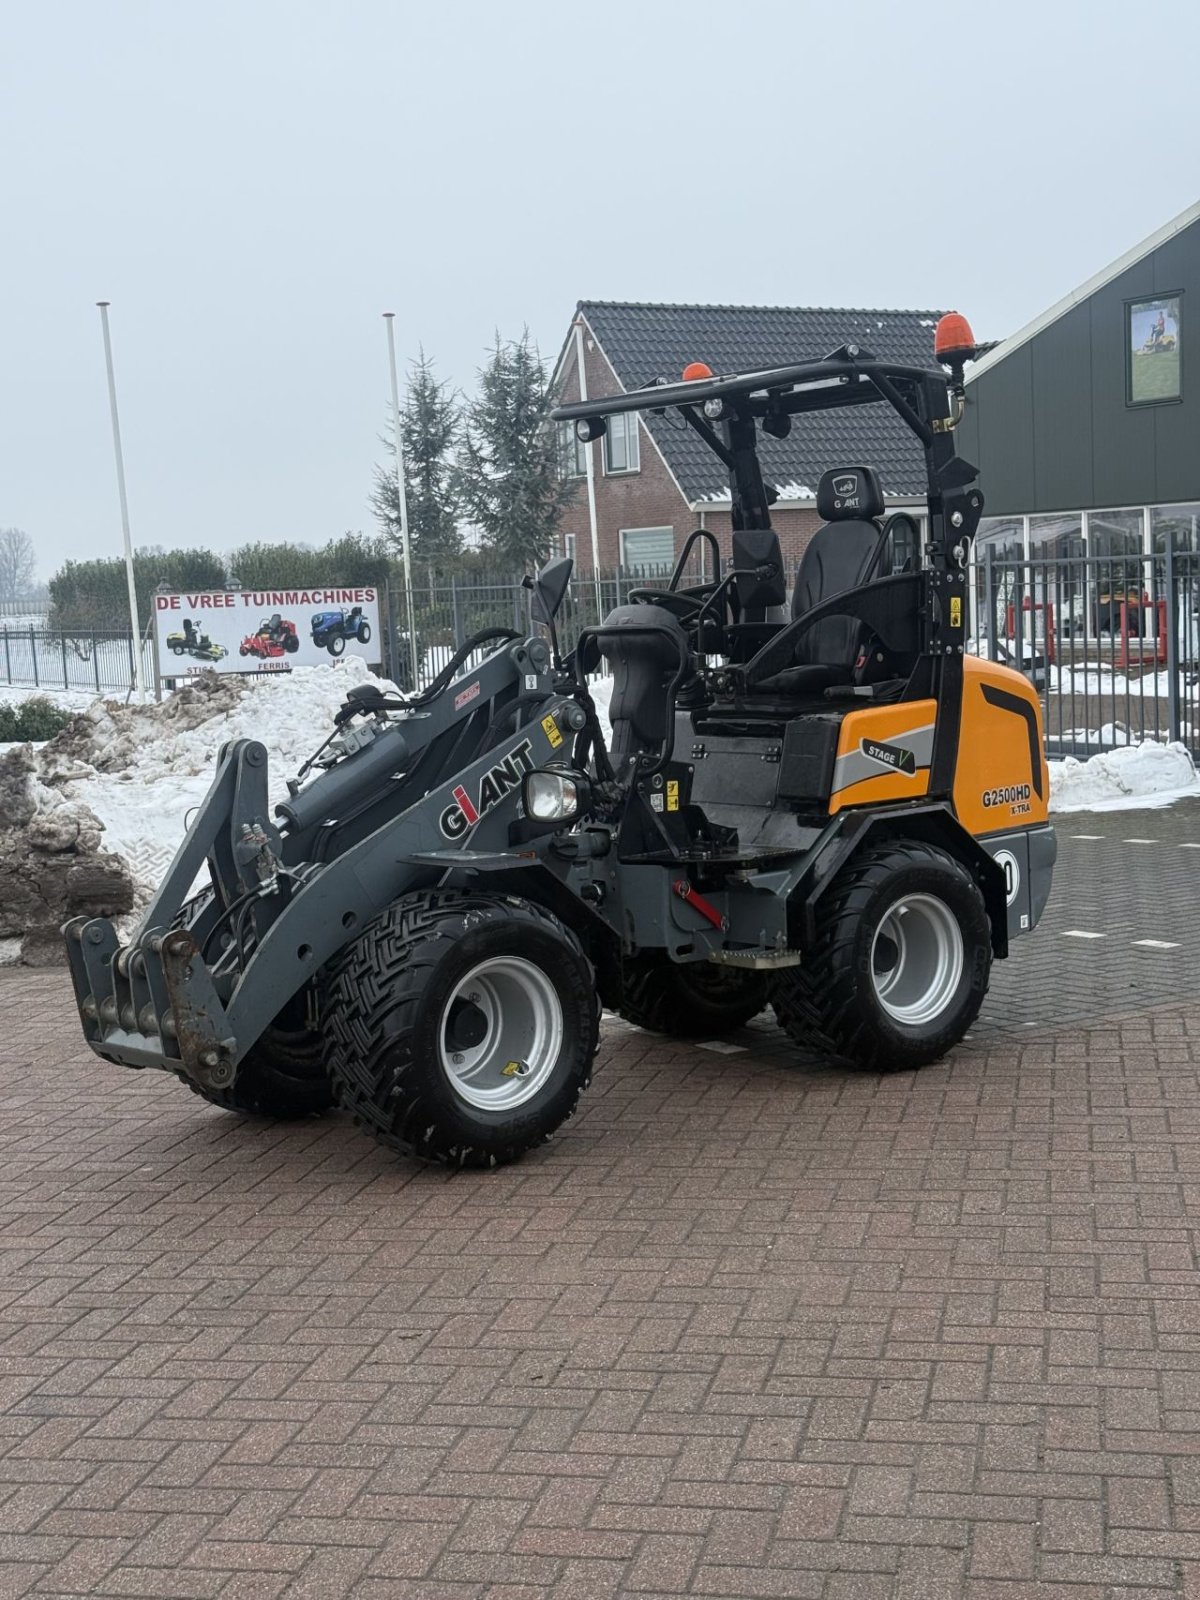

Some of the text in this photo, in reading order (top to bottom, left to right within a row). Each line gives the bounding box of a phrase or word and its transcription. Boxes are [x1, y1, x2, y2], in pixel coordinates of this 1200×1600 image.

[834, 497, 860, 509] GANT
[157, 589, 375, 610] DE VREE TUINMACHINES
[258, 662, 290, 670] FERRIS
[868, 745, 896, 764] STAGE
[439, 737, 537, 840] GIANT
[982, 783, 1031, 809] G2500HD
[1010, 803, 1031, 816] X-TRA
